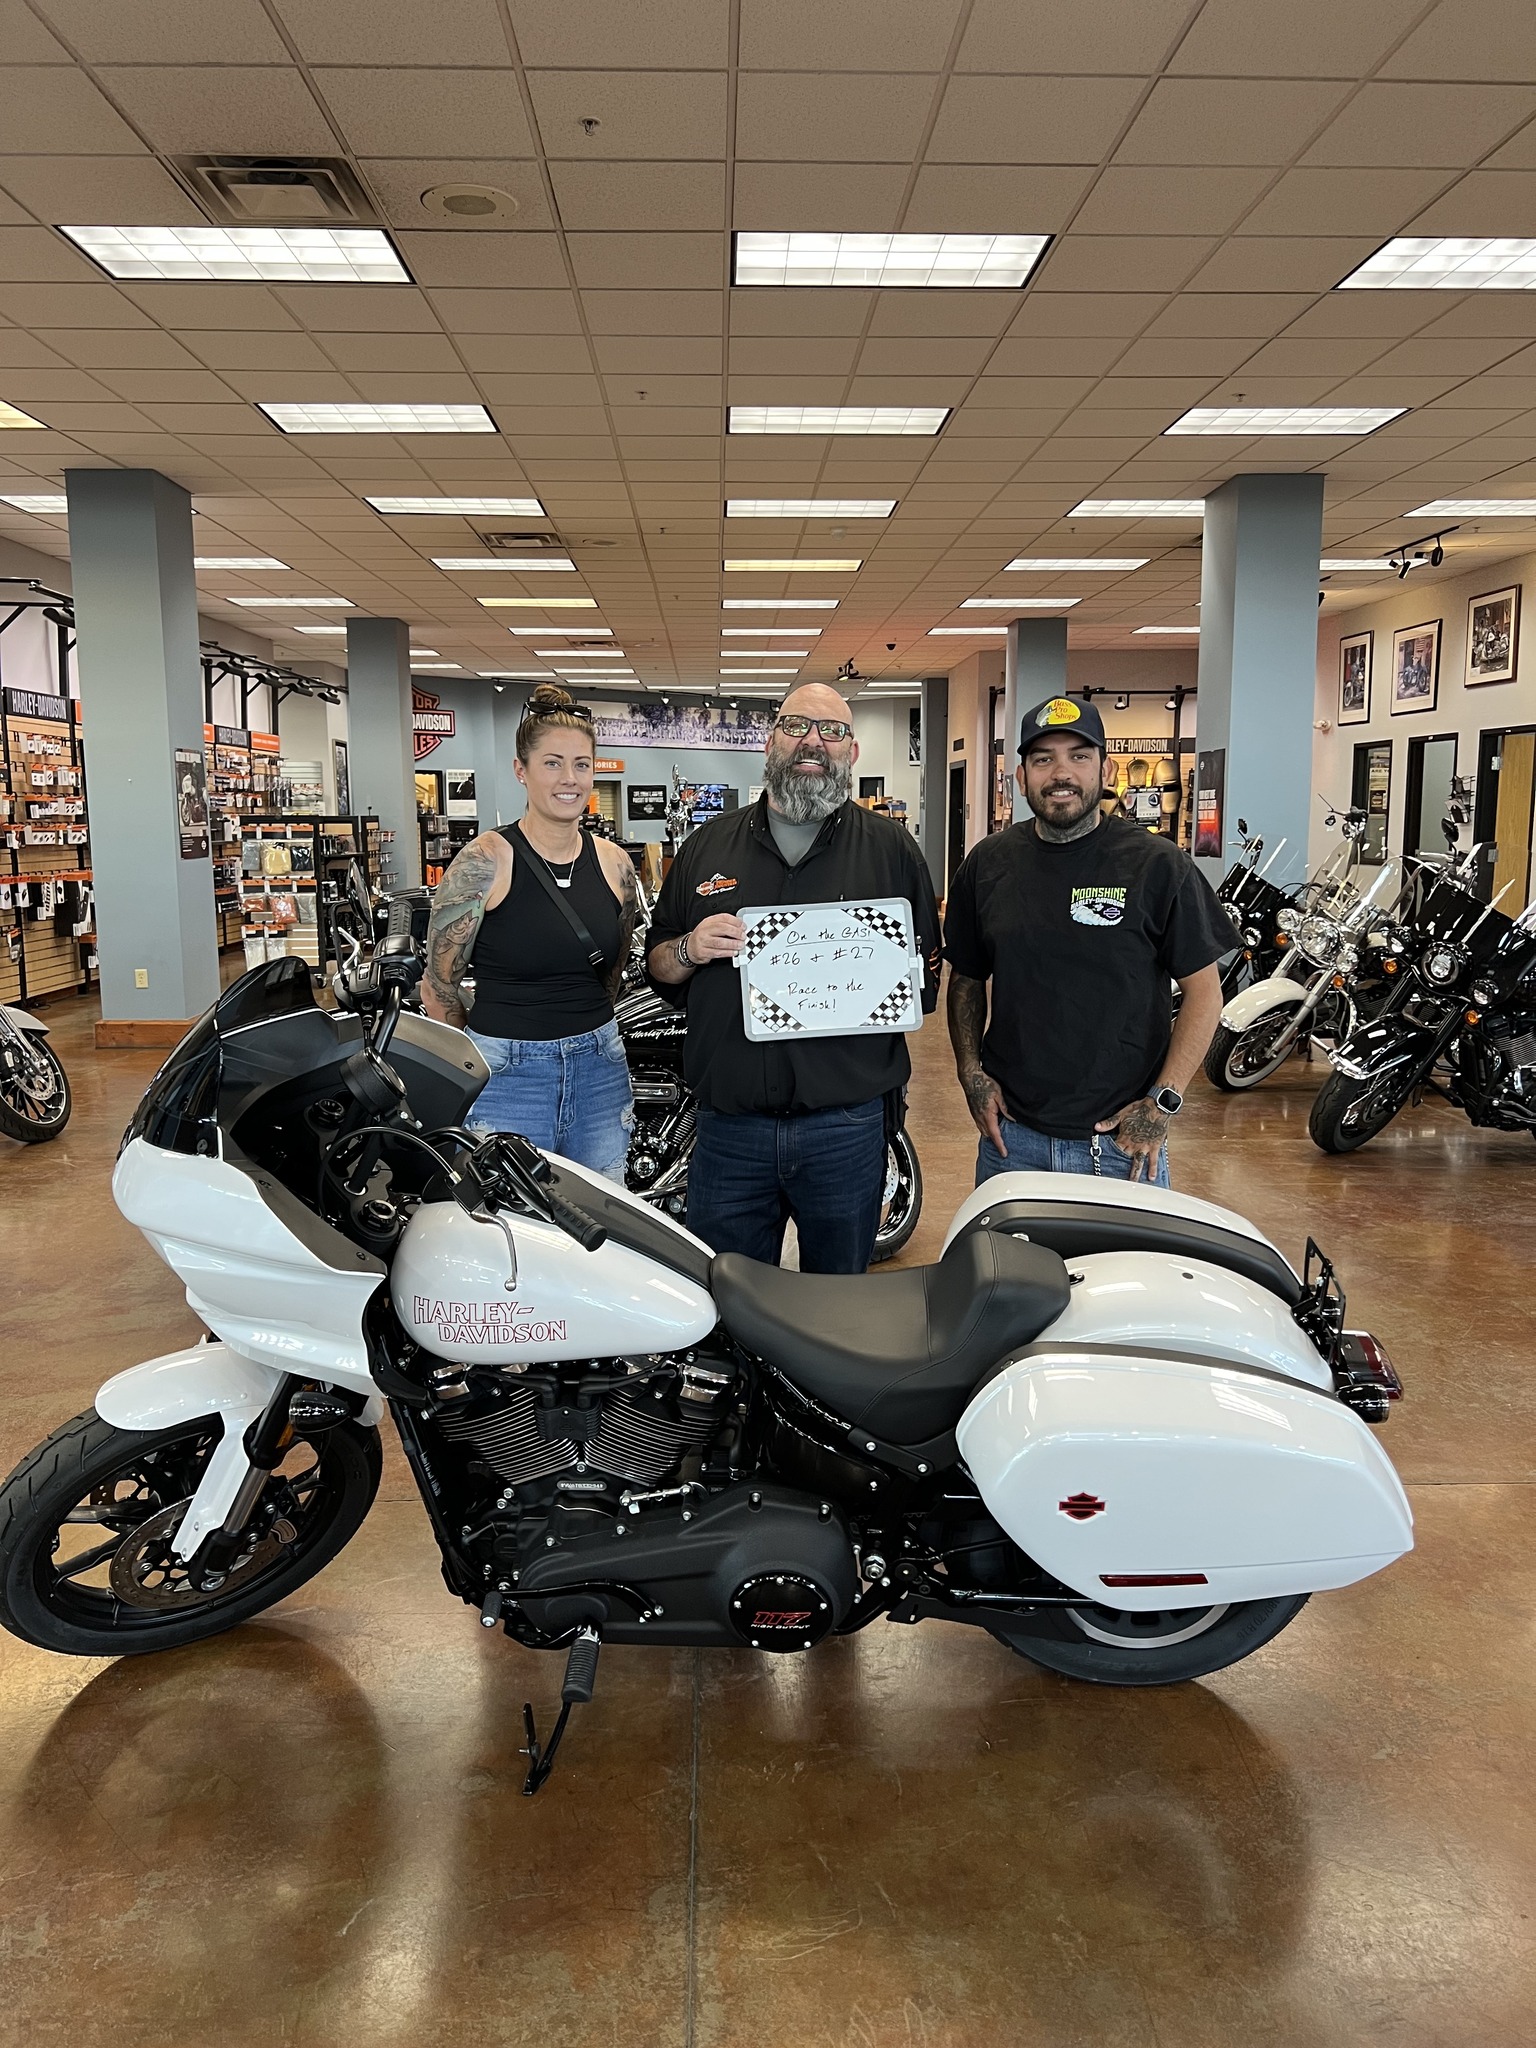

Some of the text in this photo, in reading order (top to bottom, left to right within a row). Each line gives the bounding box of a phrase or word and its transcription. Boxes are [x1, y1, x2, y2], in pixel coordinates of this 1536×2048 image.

[11, 690, 67, 720] HARLEY-DAVIDSON
[414, 693, 433, 709] OR
[1055, 713, 1077, 721] Shops
[414, 735, 434, 755] LES
[1106, 739, 1168, 752] RLEY-DAVIDSON
[1071, 887, 1127, 903] MOONSHINE
[786, 931, 807, 944] On
[818, 928, 835, 940] the
[769, 952, 800, 966] #26
[788, 978, 864, 996] Race to the
[797, 998, 836, 1012] Finish!
[413, 1295, 535, 1324] HARLEY-
[438, 1320, 567, 1344] DAVIDSON
[753, 1611, 811, 1625] 117
